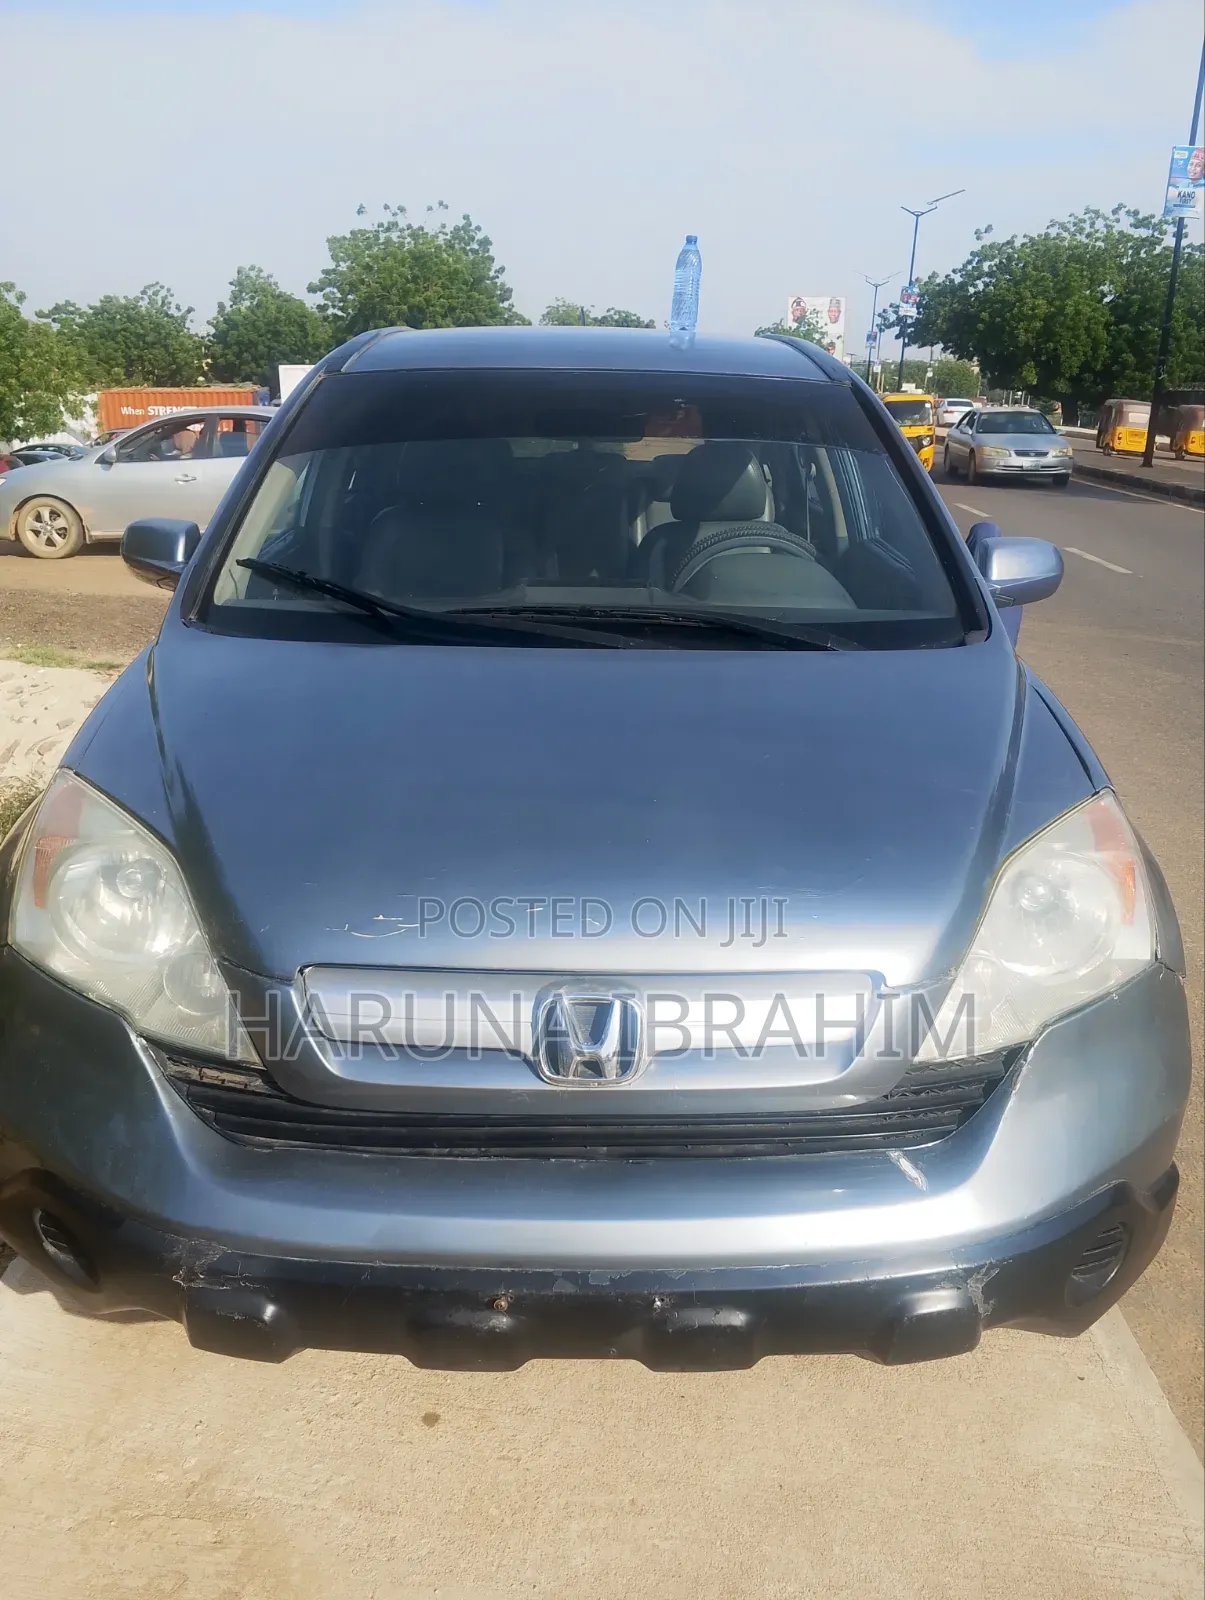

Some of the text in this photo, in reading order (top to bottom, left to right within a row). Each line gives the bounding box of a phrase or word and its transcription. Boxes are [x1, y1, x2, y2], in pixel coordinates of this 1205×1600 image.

[1178, 190, 1195, 199] KANO
[121, 405, 198, 416] When STREN
